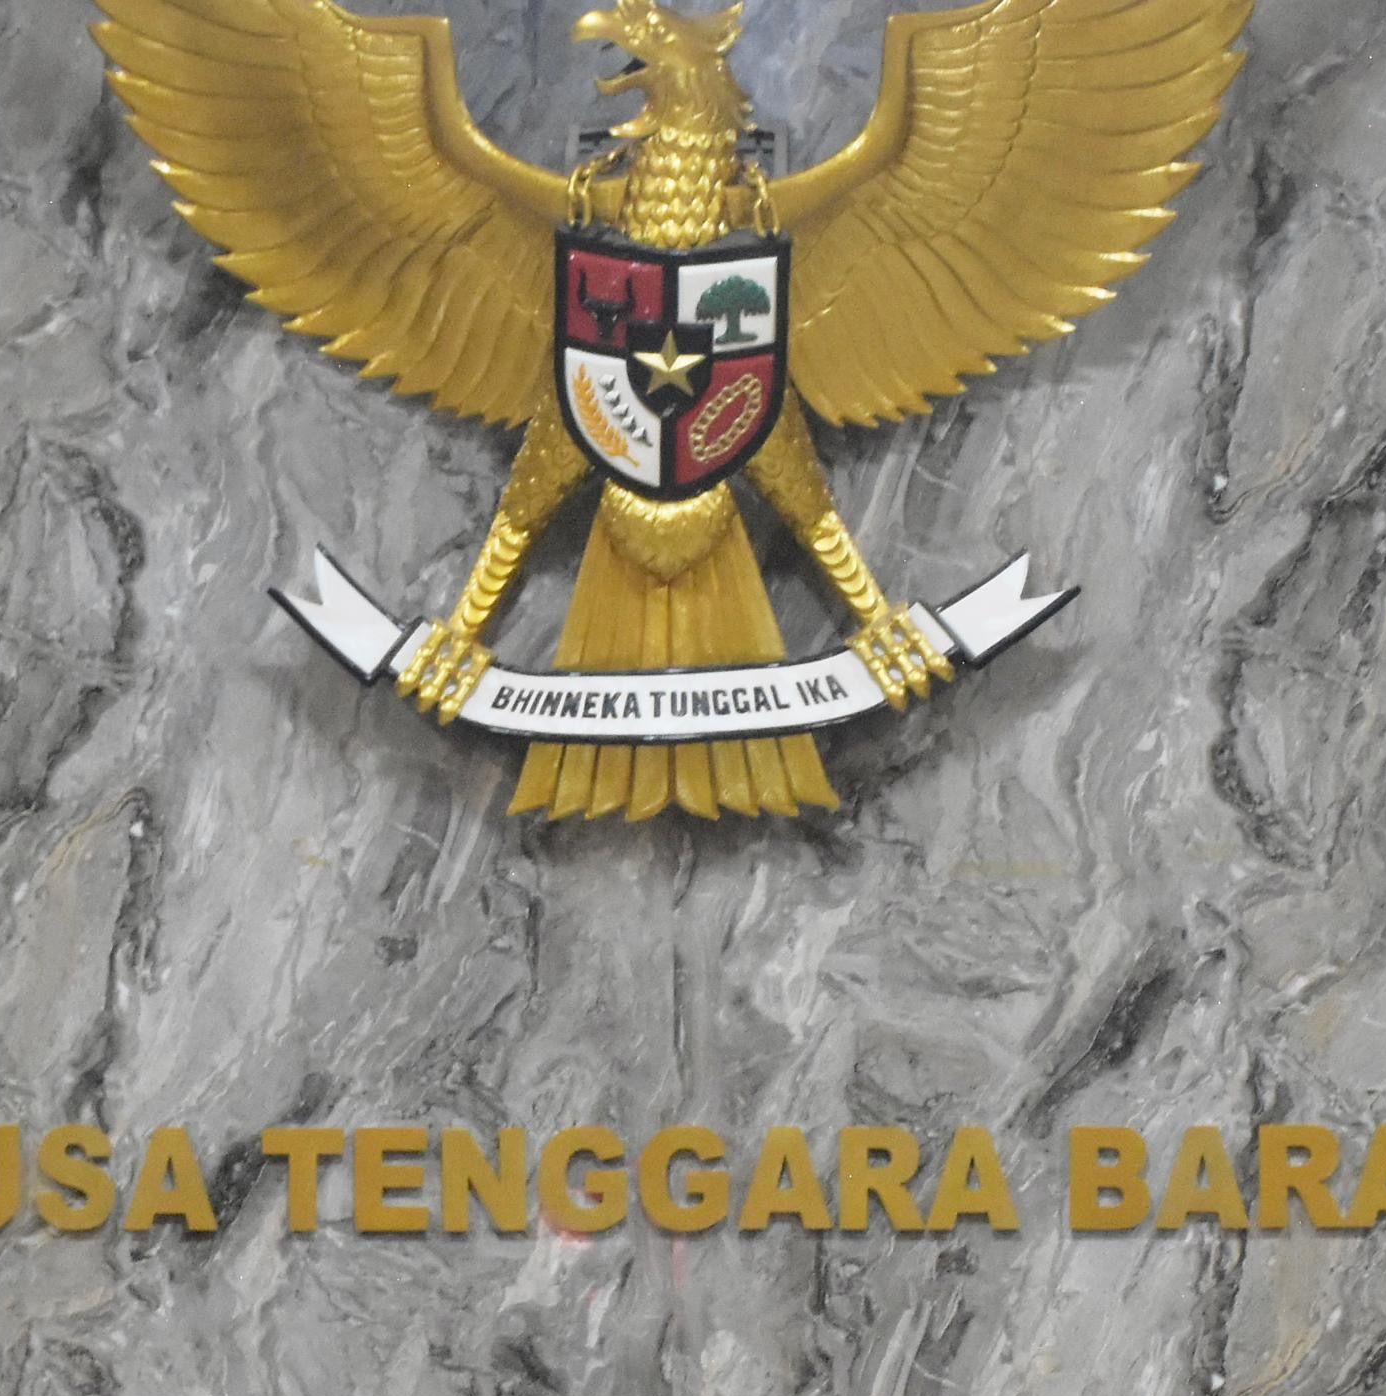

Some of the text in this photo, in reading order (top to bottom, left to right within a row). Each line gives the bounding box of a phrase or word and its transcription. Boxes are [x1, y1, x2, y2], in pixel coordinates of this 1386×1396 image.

[491, 674, 848, 719] BHINNEKA TUNGGAL IKA
[260, 1124, 1020, 1235] TENGGARA
